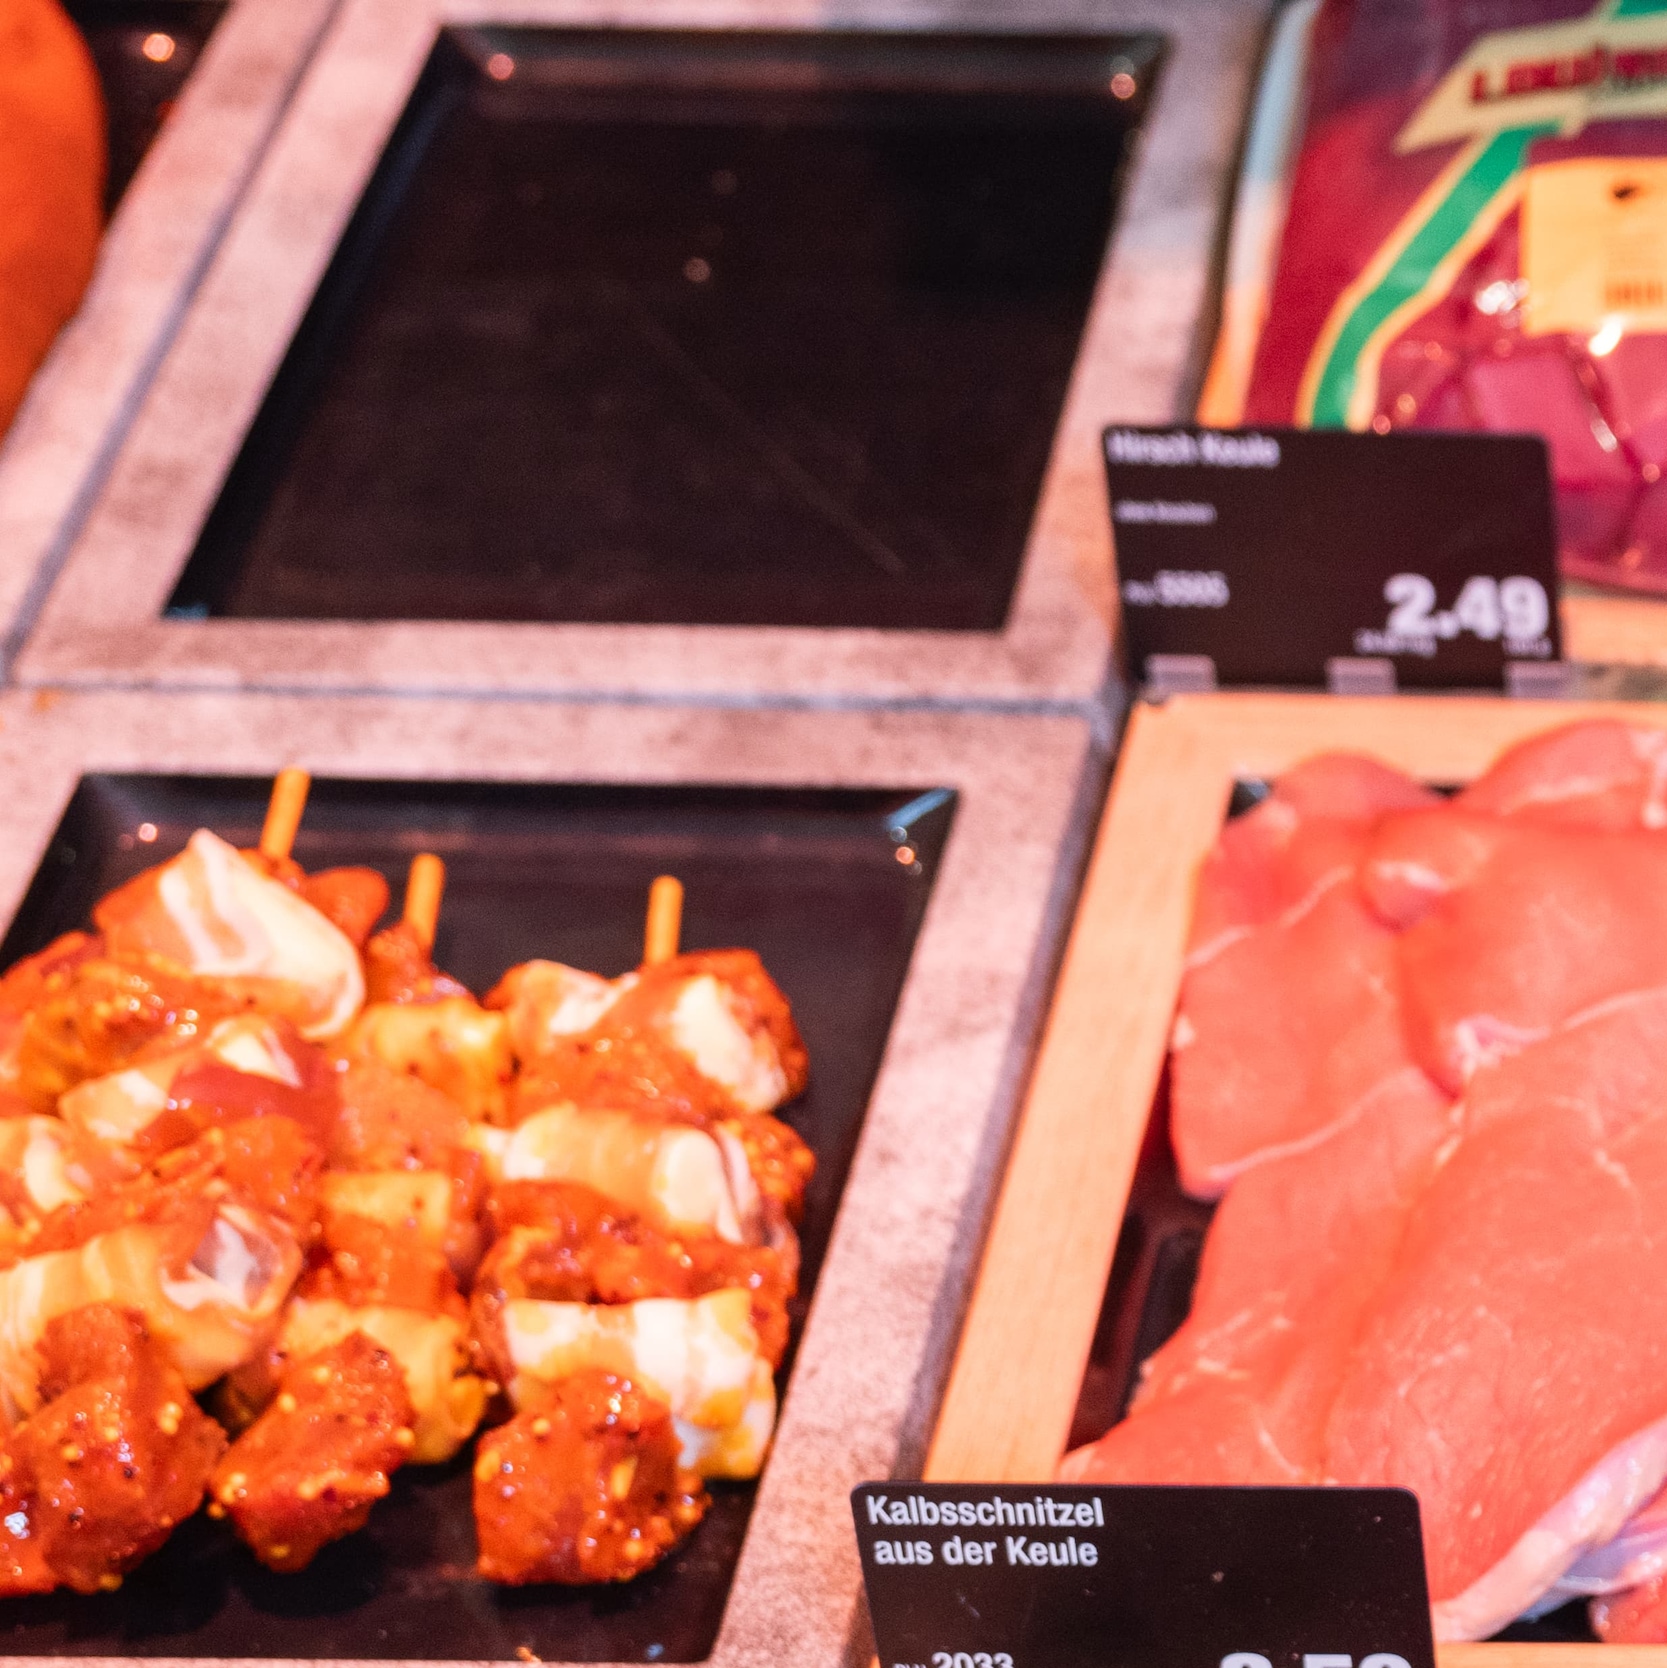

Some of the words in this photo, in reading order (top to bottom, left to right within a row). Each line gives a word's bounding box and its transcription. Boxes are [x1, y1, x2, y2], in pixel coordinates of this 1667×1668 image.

[1201, 433, 1281, 468] Keule
[1384, 573, 1549, 641] 2.49
[867, 1495, 1104, 1526] Kalbsschnitzel
[874, 1540, 934, 1565] aus
[942, 1536, 994, 1566] der
[1007, 1537, 1098, 1567] Keule
